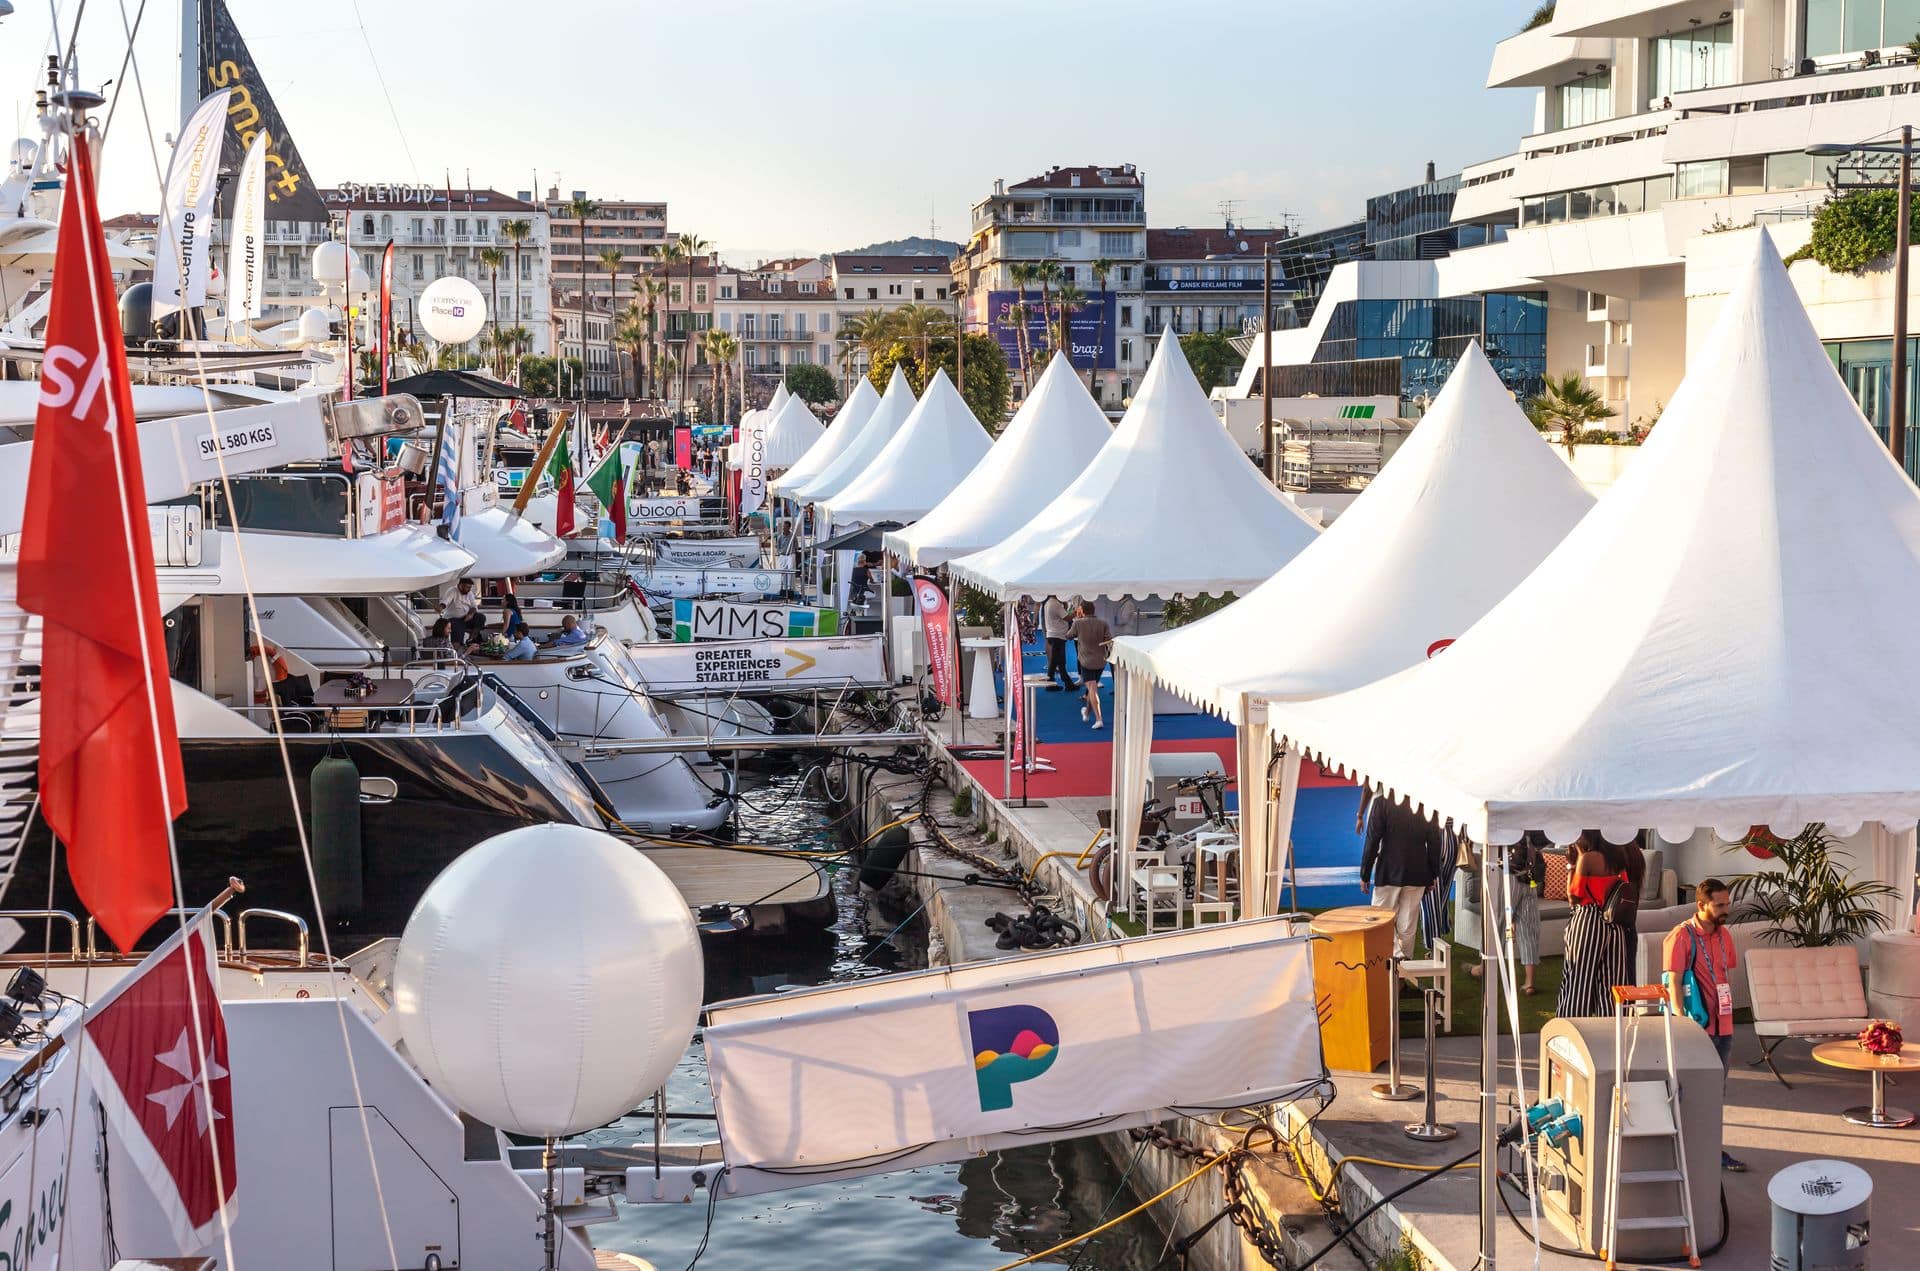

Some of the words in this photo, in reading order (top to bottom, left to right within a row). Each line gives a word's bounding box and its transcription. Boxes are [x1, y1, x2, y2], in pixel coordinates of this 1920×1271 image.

[184, 124, 209, 208] Interactive
[337, 182, 434, 203] SPLENDID
[1242, 315, 1265, 334] CASIN
[1072, 343, 1103, 358] braze
[201, 438, 225, 453] SWL
[227, 433, 247, 448] 580
[249, 428, 272, 443] KGS
[749, 429, 763, 495] rubicon
[629, 504, 686, 517] ubicon
[694, 605, 784, 638] MMS
[695, 649, 751, 661] GREATER
[696, 658, 781, 672] EXPERIENCES
[696, 673, 738, 682] START
[738, 670, 770, 682] HERE
[968, 1005, 1059, 1112] P
